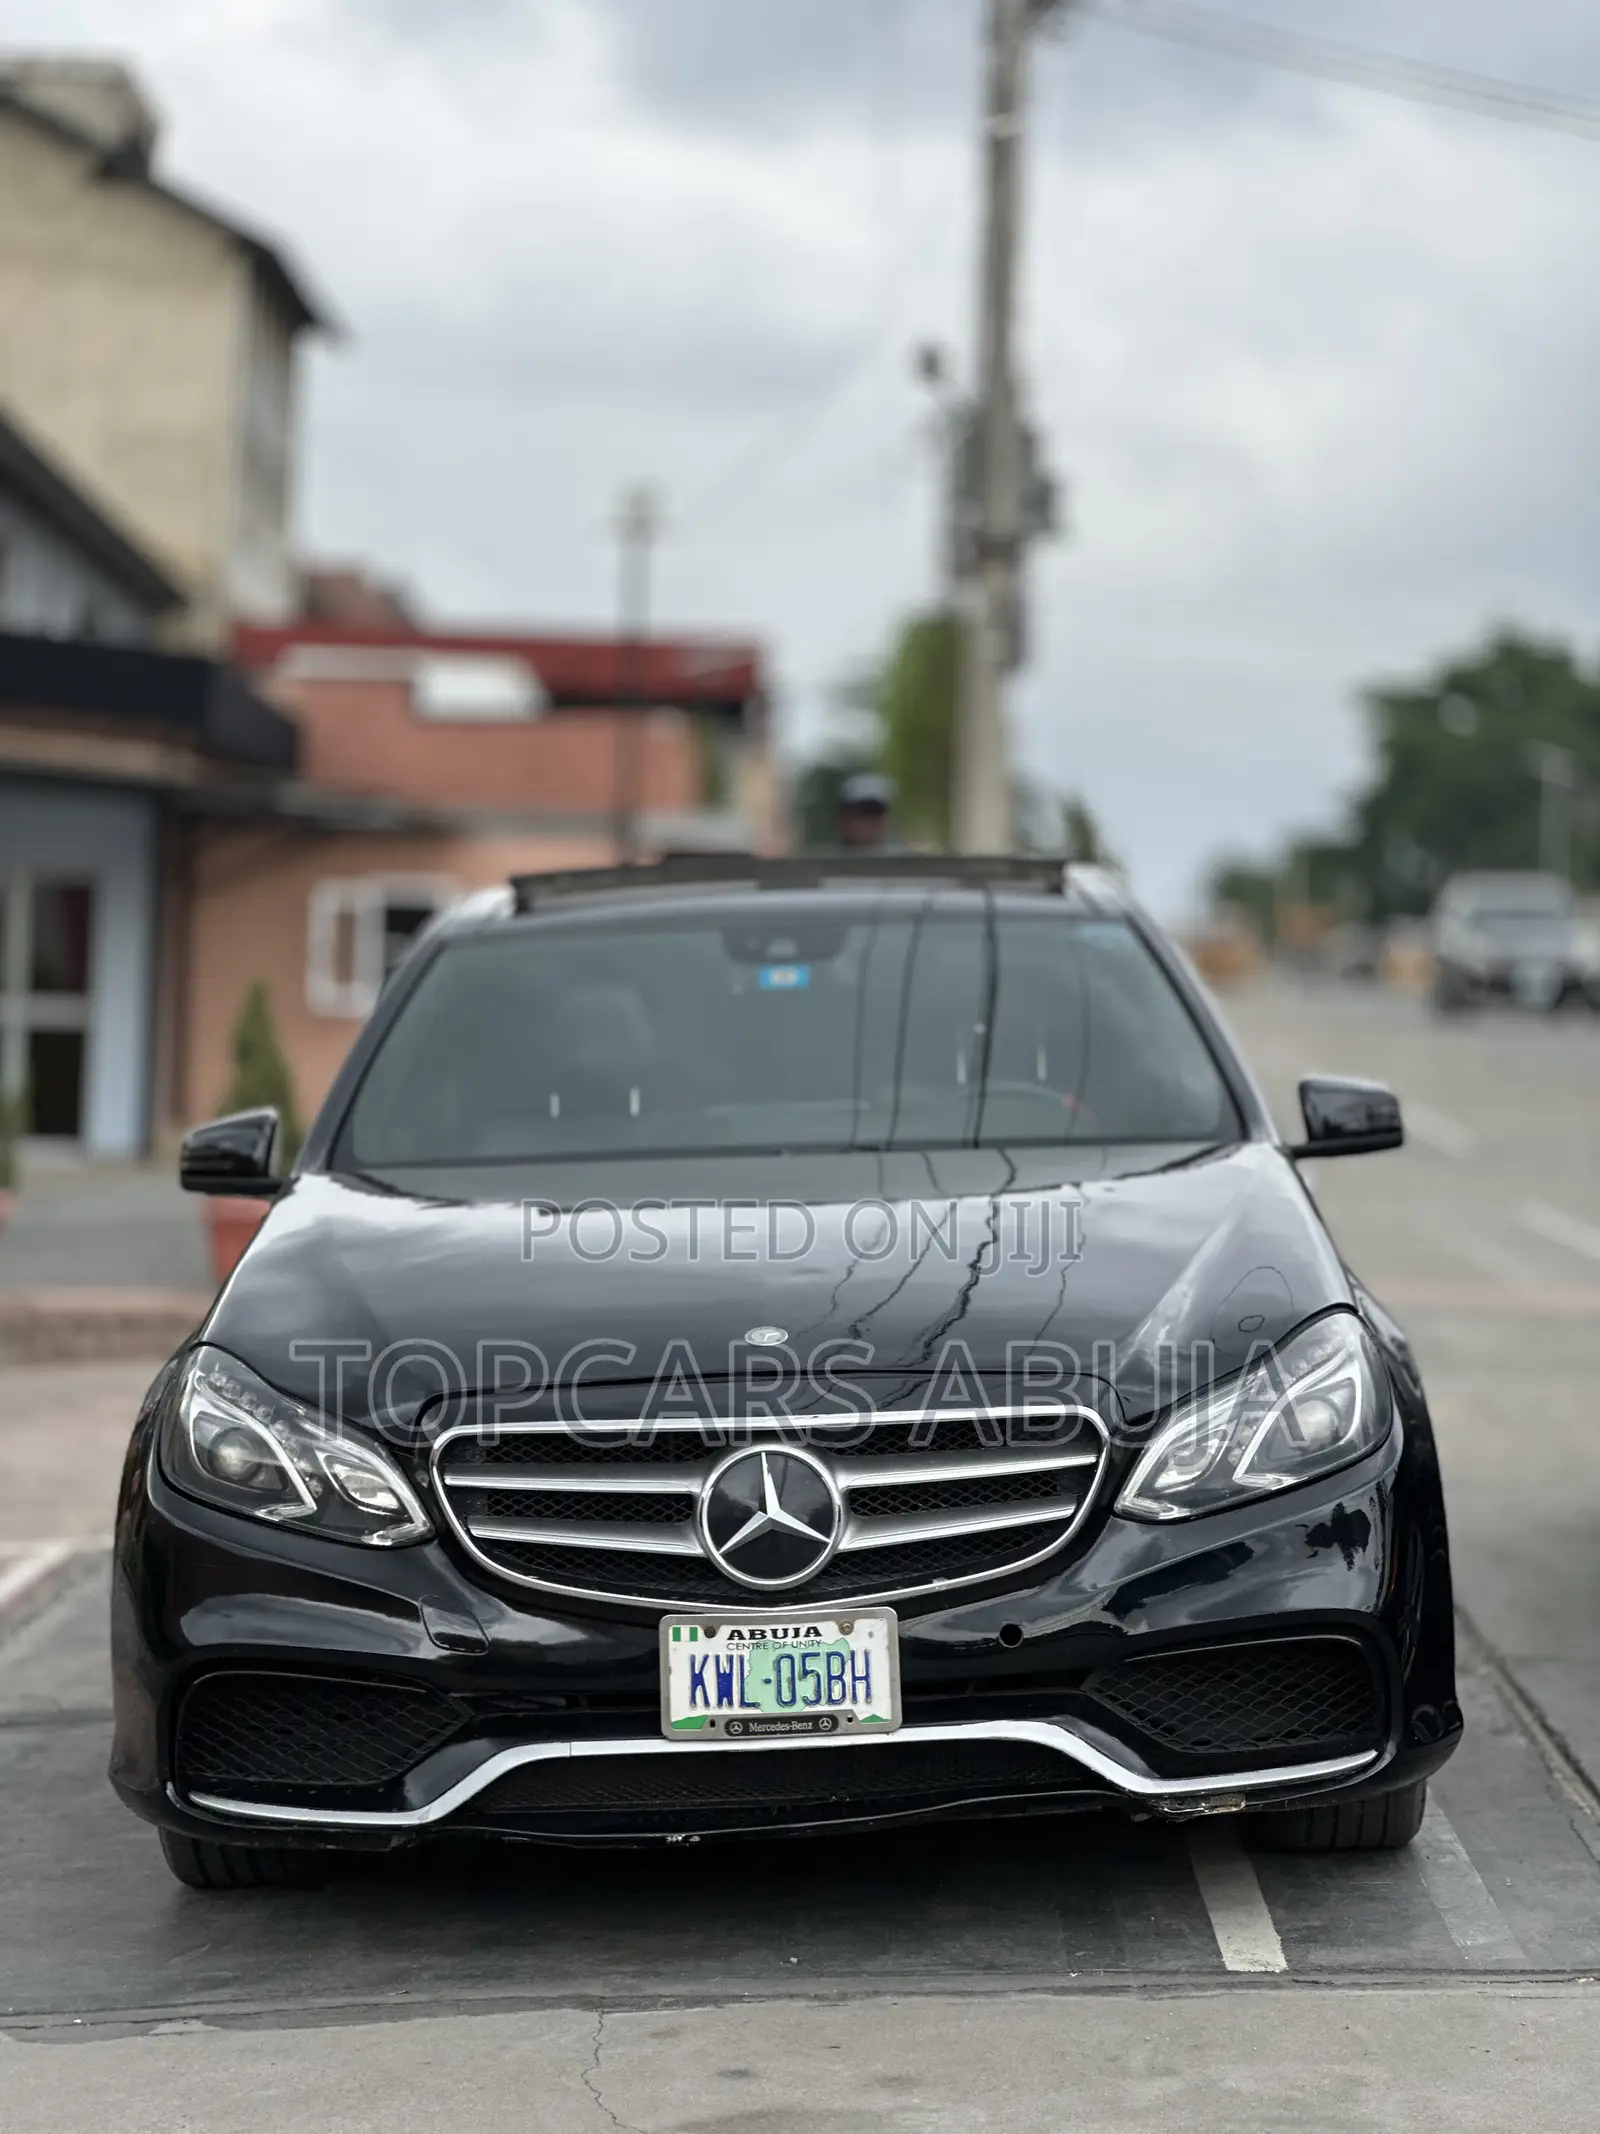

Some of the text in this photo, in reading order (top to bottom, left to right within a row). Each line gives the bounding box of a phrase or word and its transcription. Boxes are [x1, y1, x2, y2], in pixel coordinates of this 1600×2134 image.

[727, 1626, 822, 1641] ABUJA
[727, 1640, 822, 1651] CENTRE OF UNITY
[749, 1722, 813, 1733] Mercedes-Benz
